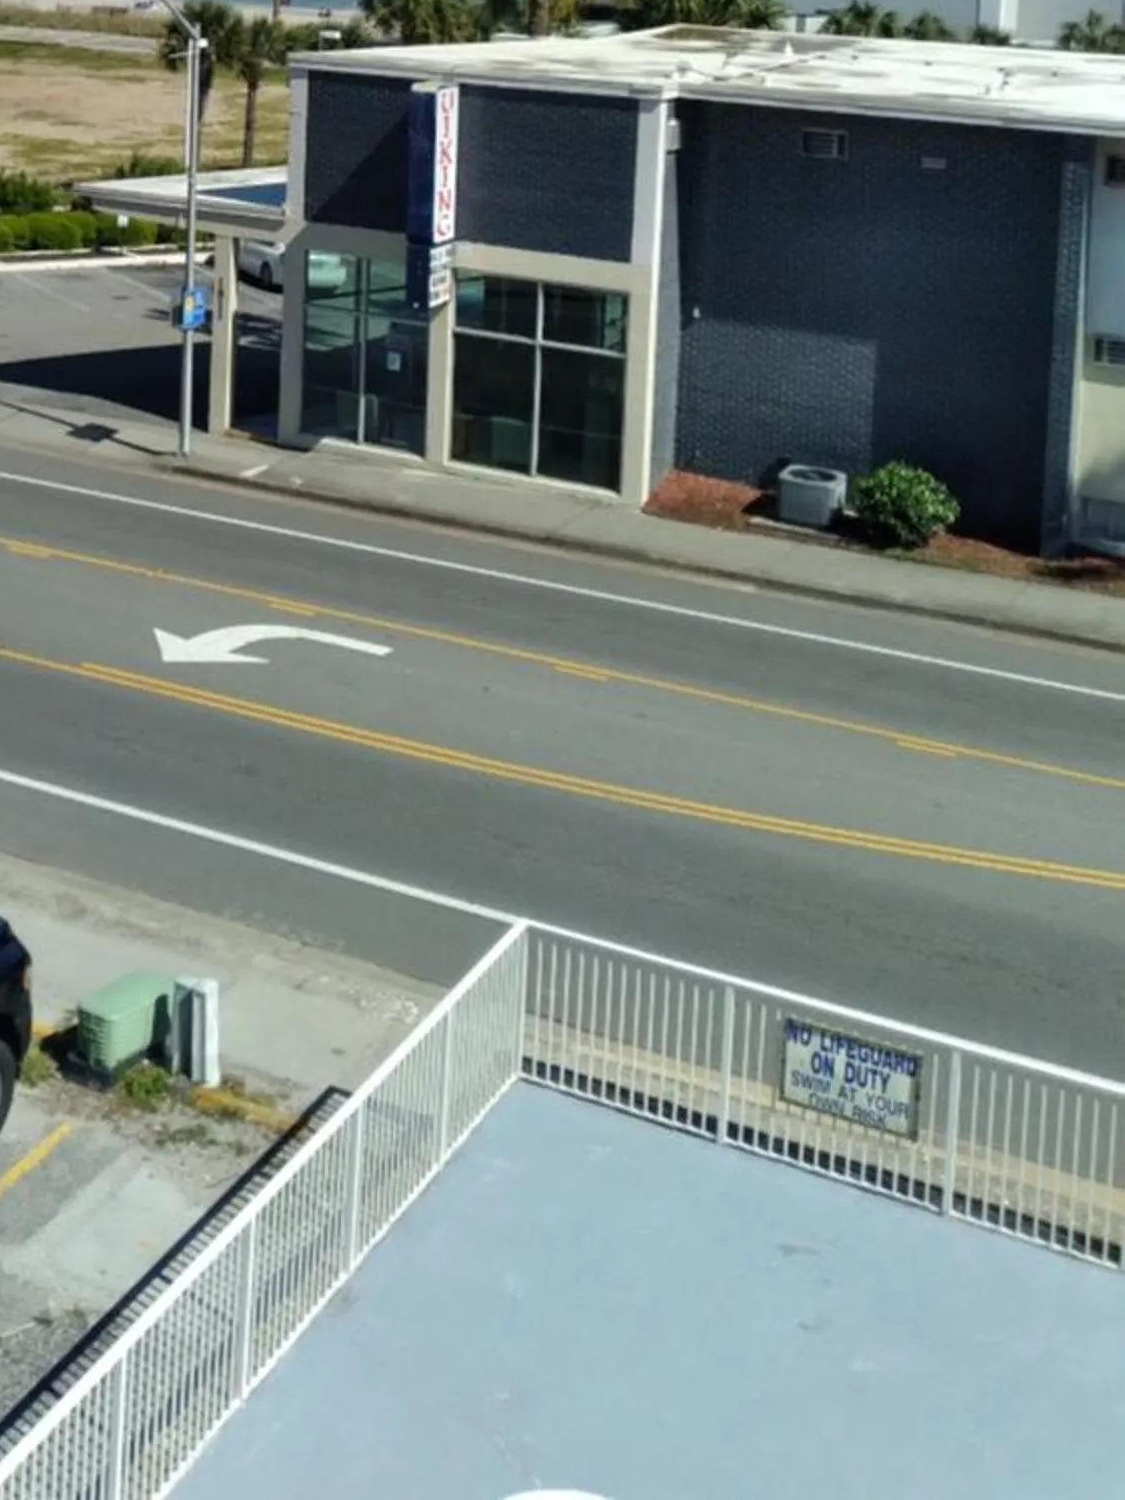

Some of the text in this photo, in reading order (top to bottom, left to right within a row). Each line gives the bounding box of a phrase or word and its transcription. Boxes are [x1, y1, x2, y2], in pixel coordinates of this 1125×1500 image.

[784, 1021, 918, 1076] NO LIFEGUARD
[792, 1071, 908, 1117] SWIM AT YOUR
[811, 1052, 891, 1093] ON DUTY
[852, 1105, 887, 1126] RISK
